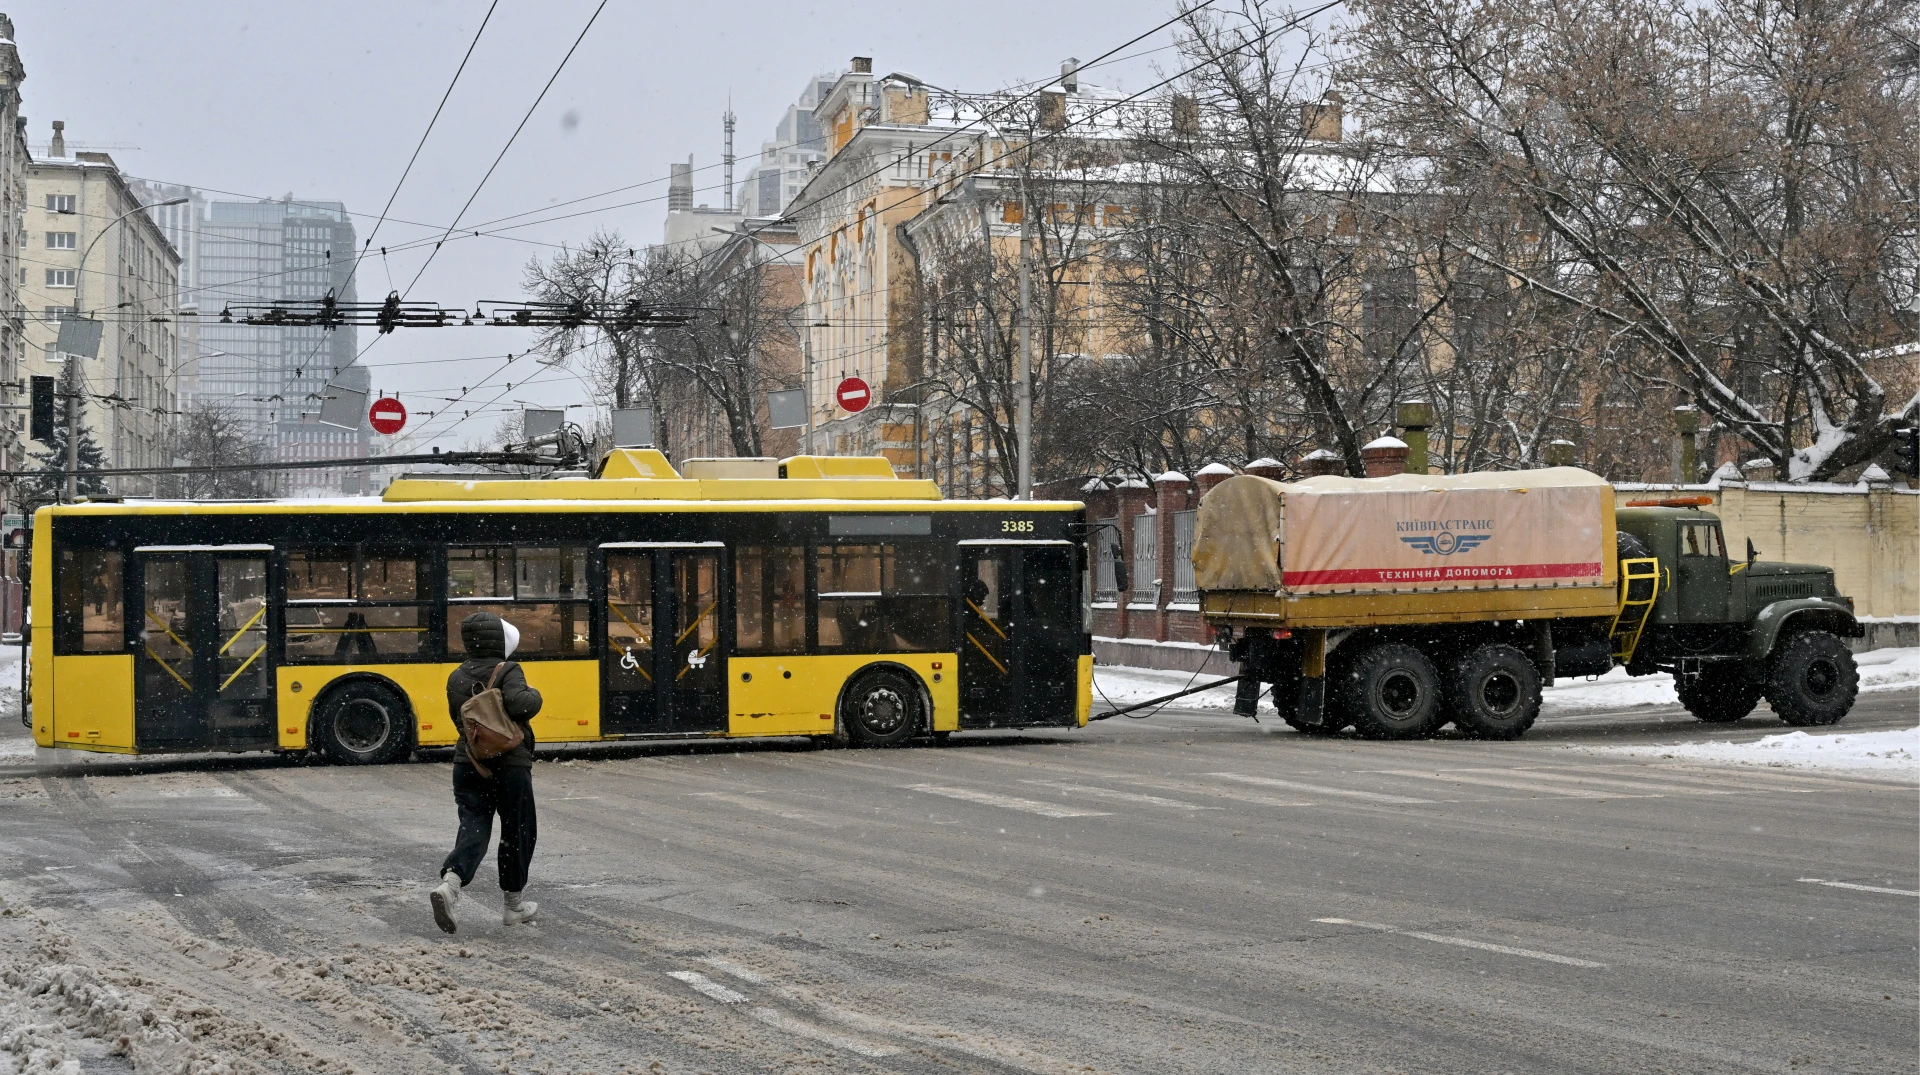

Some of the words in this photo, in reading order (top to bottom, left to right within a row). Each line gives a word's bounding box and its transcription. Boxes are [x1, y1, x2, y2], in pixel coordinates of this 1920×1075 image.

[1001, 520, 1034, 532] 3385
[1396, 519, 1495, 532] КИЇВПАСТРАНС
[1379, 569, 1440, 579] ТЕХНІЧНА
[1446, 567, 1513, 577] ДОПОМОГА
